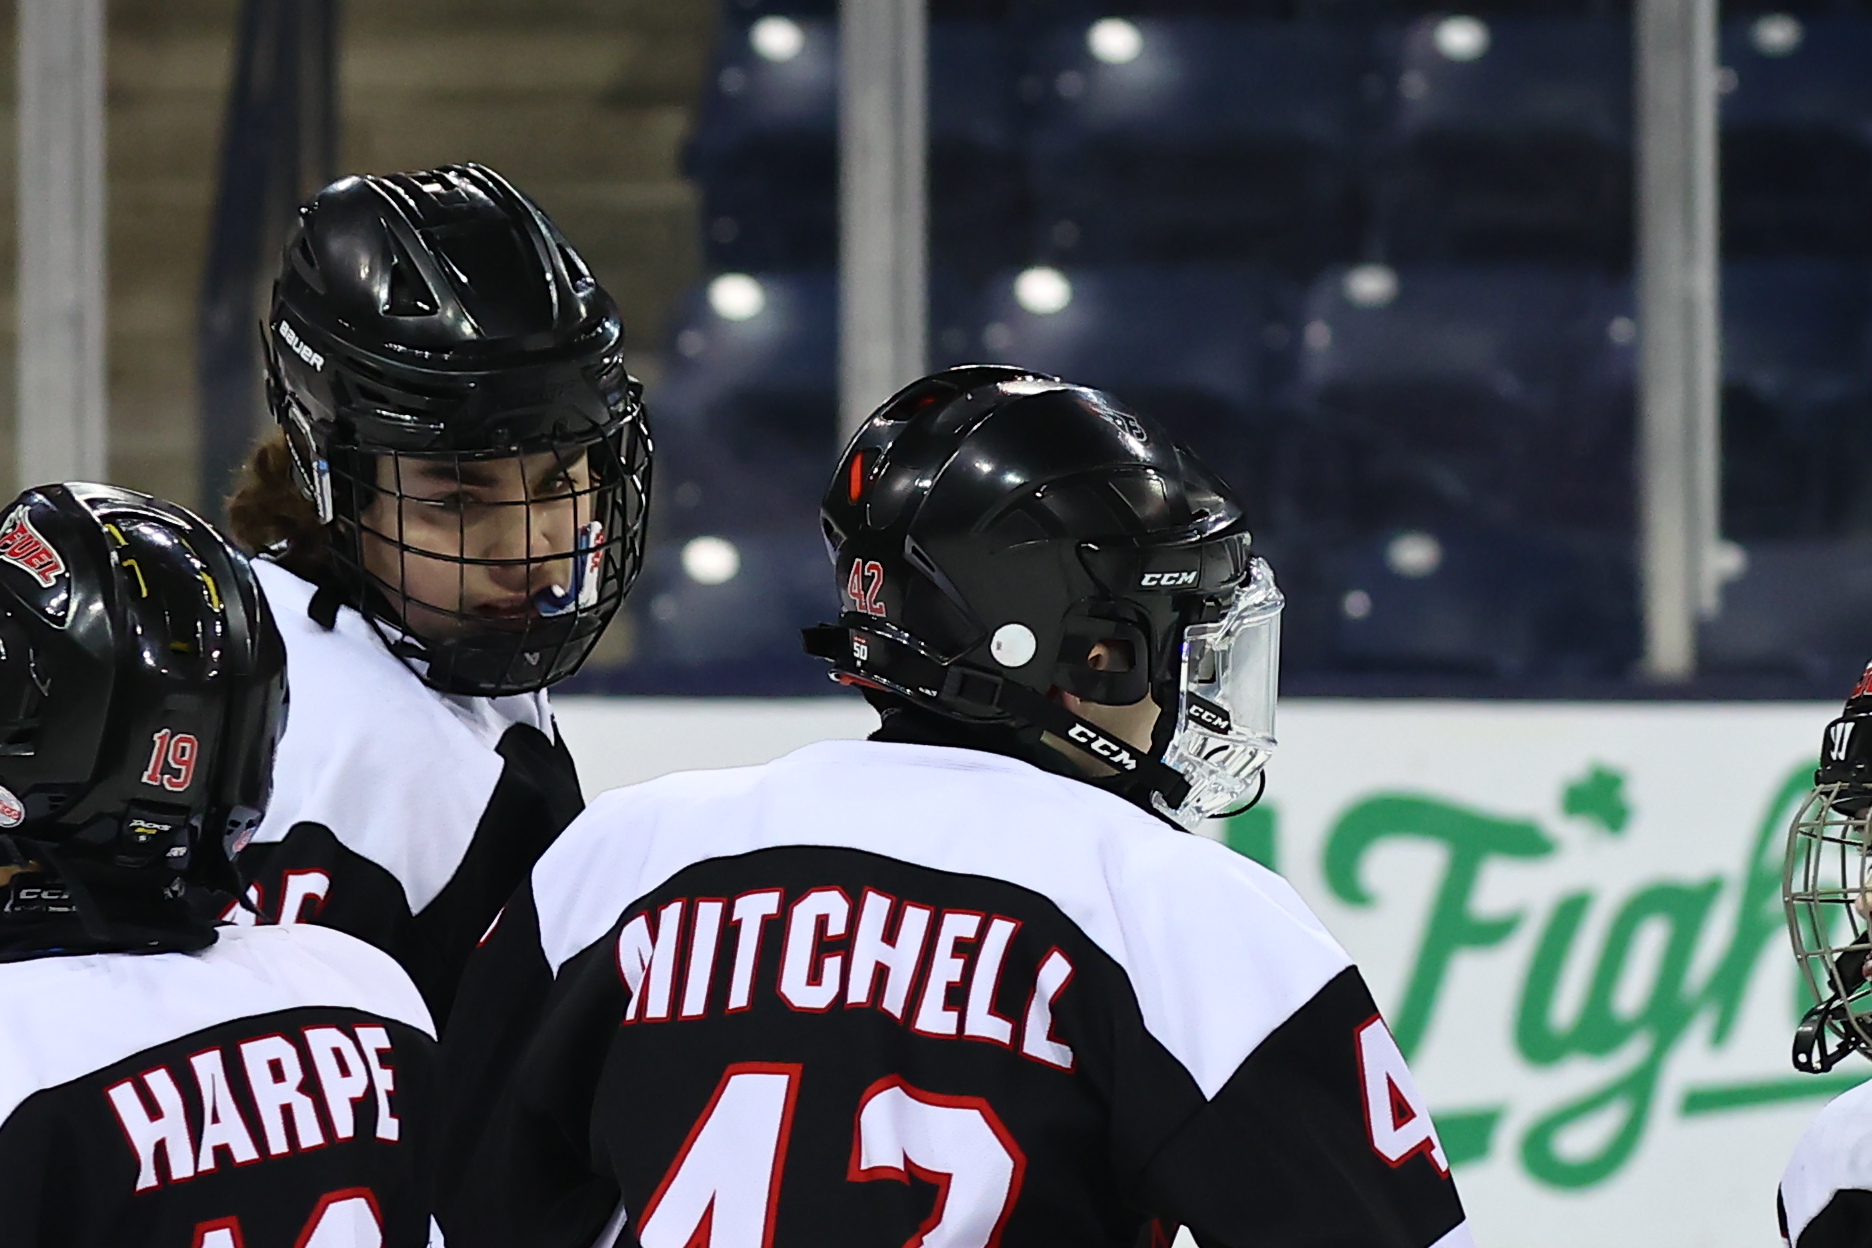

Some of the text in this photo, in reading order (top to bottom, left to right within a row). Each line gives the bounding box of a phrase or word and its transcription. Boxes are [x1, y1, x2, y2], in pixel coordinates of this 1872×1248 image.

[279, 319, 325, 372] BAUER
[847, 558, 887, 617] 42
[1140, 570, 1198, 587] CCM
[1189, 704, 1230, 731] CCM
[141, 728, 199, 792] 19
[1067, 722, 1138, 772] CCM
[617, 885, 1075, 1073] MITCHELL
[104, 1023, 401, 1195] HARPE
